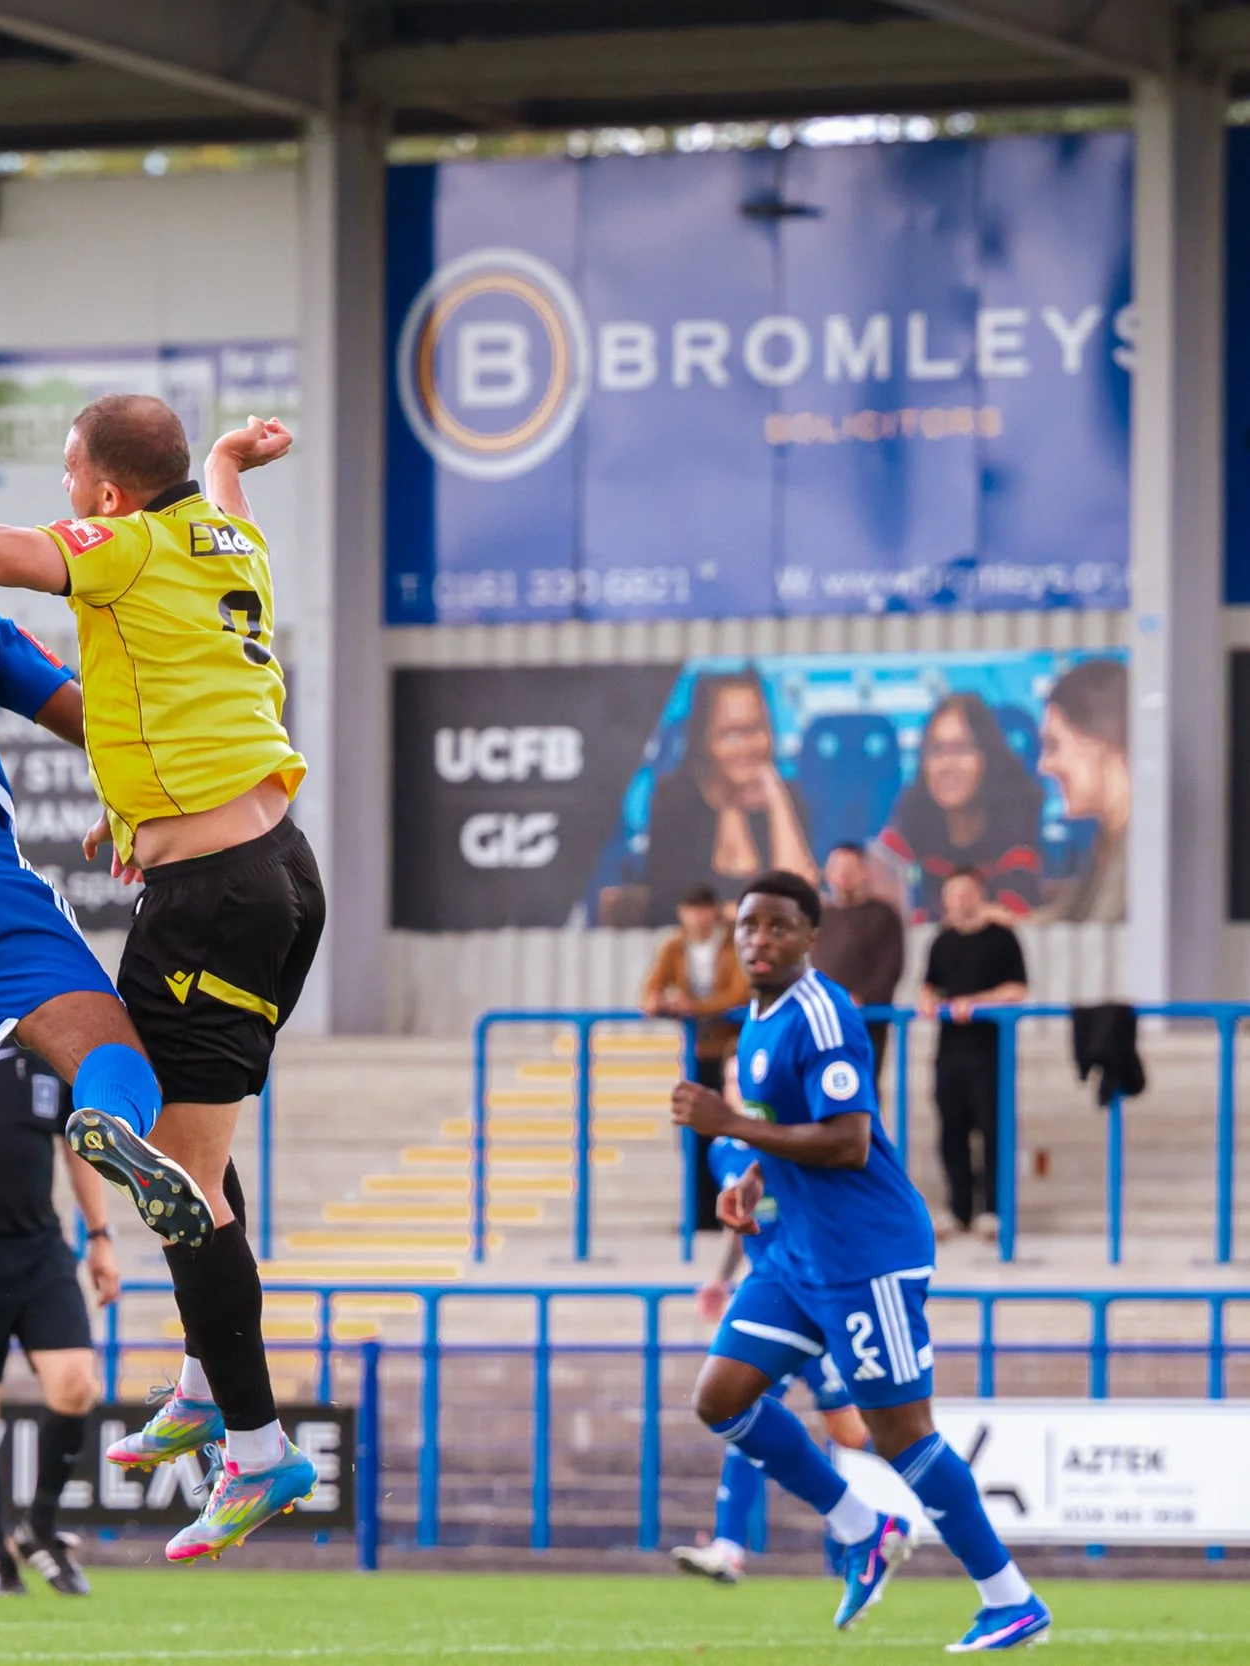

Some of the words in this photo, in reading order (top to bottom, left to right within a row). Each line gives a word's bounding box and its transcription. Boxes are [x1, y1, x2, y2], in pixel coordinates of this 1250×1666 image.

[458, 320, 532, 409] B
[434, 725, 585, 783] UCFB
[459, 811, 561, 869] GIS
[845, 1311, 881, 1361] 2
